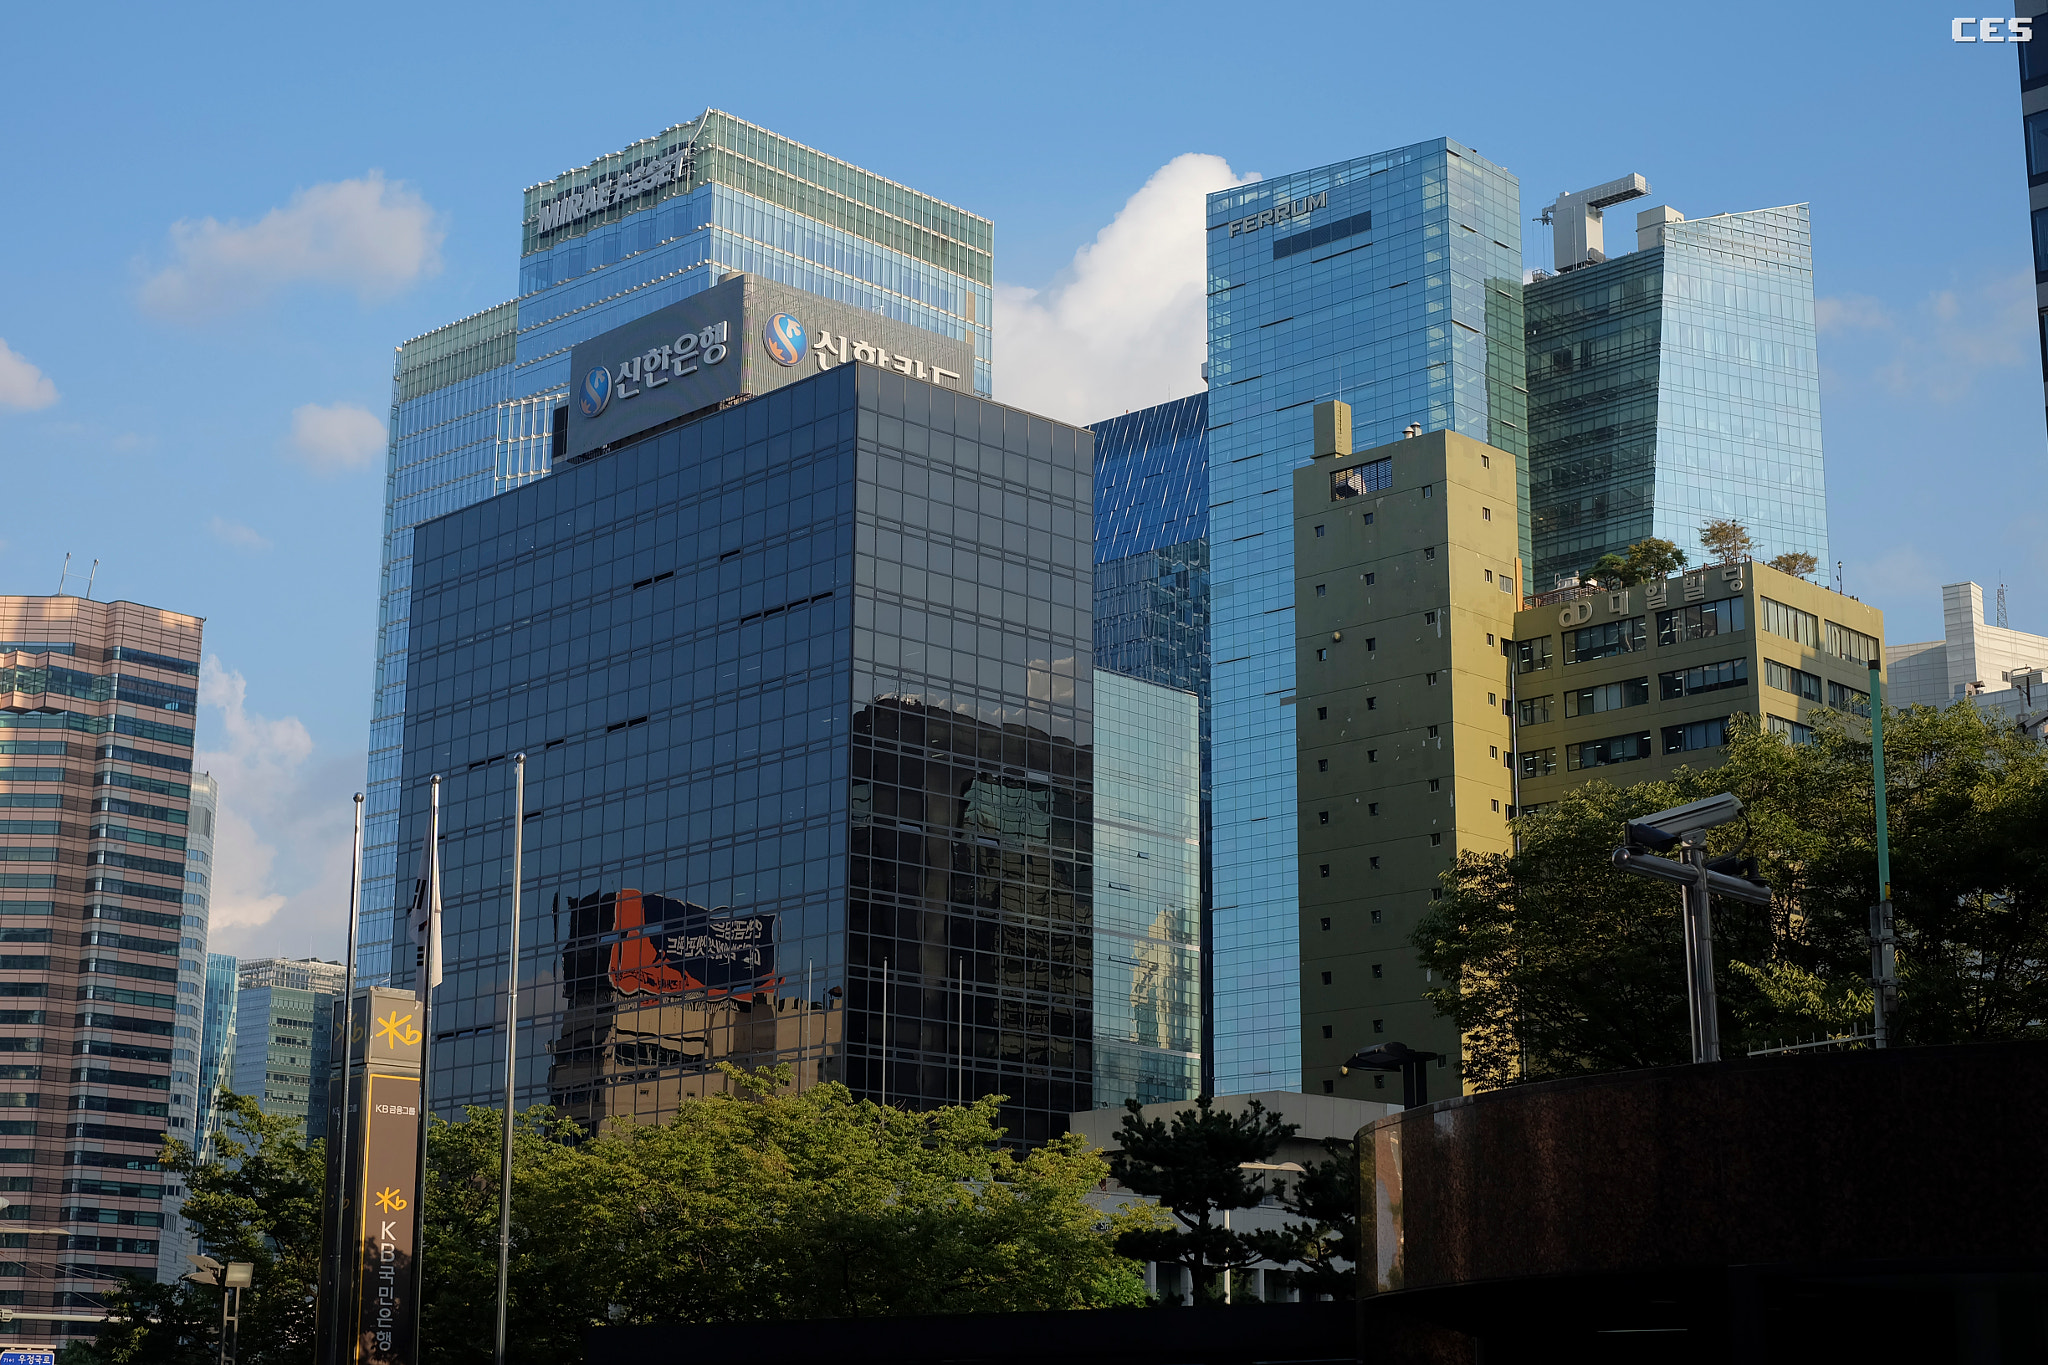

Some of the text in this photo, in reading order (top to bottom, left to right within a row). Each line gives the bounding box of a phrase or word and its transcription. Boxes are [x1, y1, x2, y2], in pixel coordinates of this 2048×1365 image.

[538, 148, 687, 234] MIRAE ASSET
[1228, 191, 1328, 238] FERRUM
[614, 320, 729, 399] 신한은행
[17, 1354, 51, 1365] 우정국로
